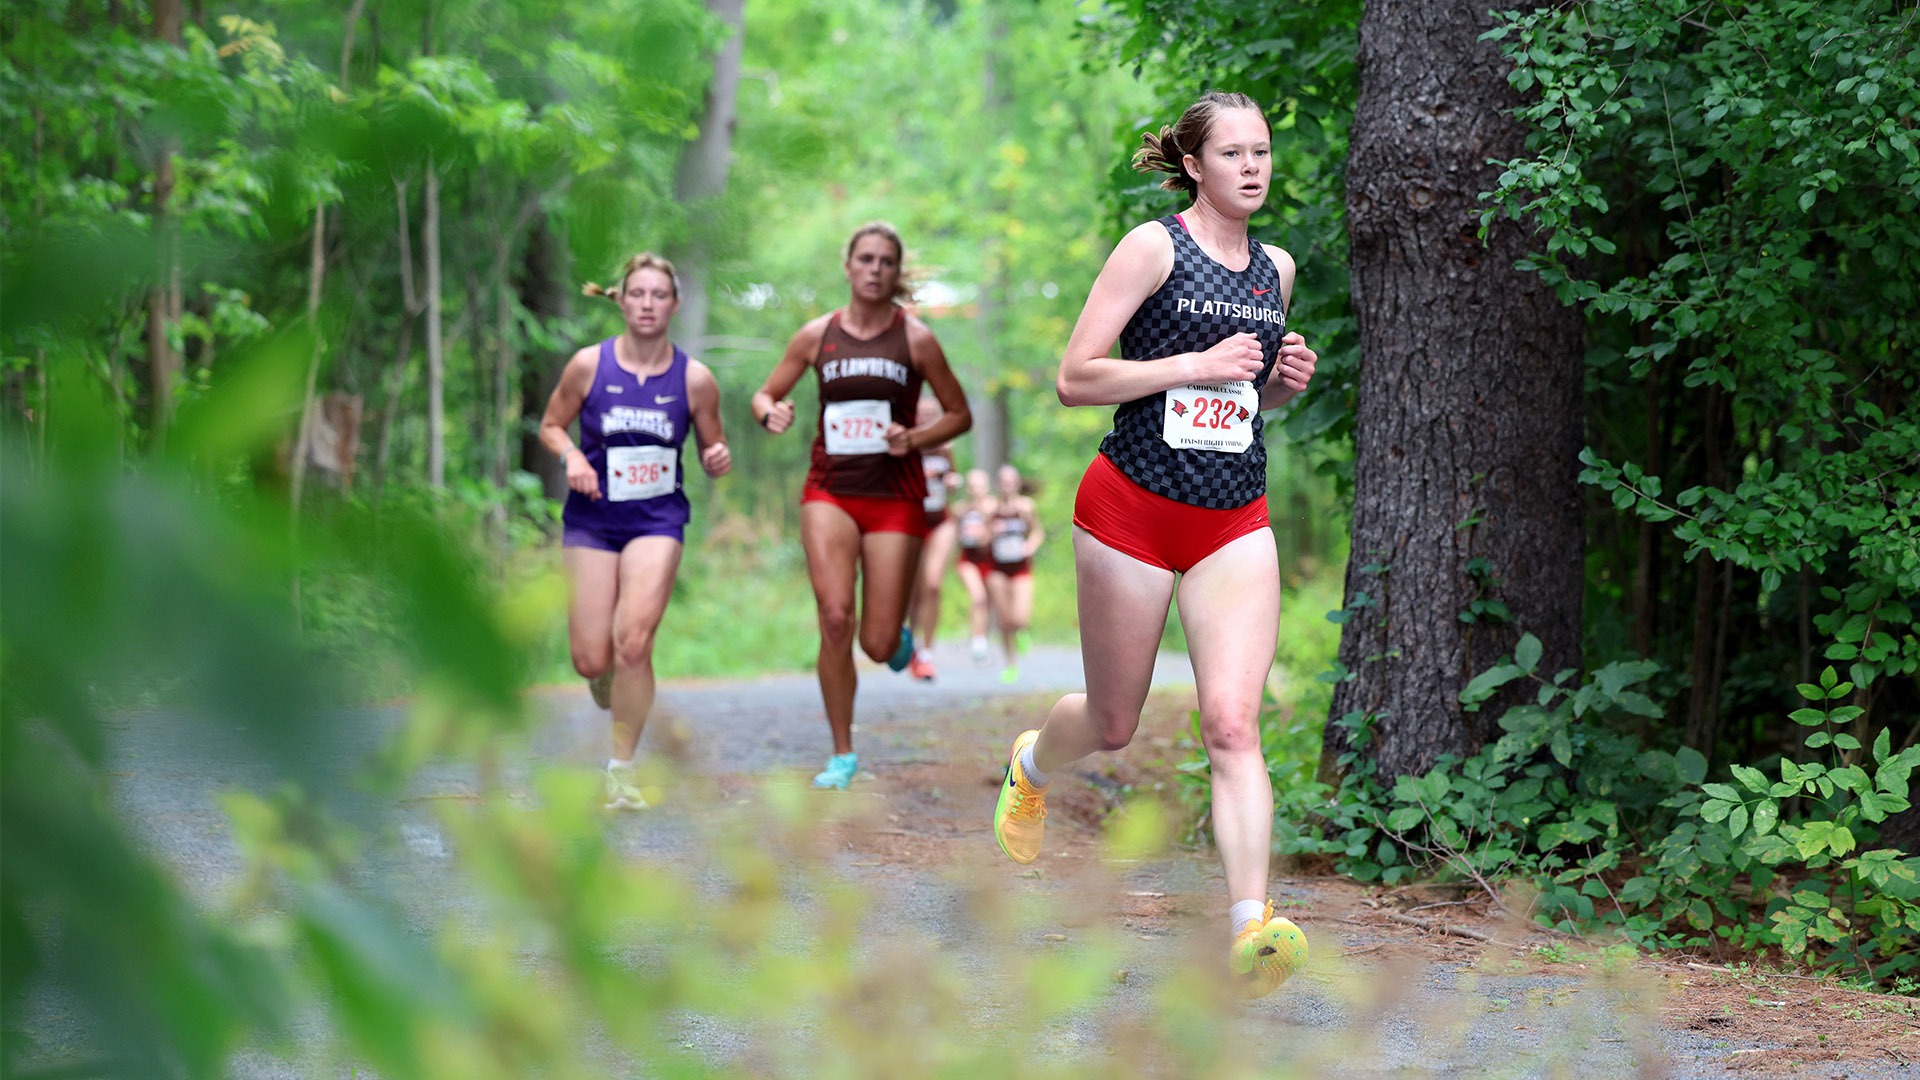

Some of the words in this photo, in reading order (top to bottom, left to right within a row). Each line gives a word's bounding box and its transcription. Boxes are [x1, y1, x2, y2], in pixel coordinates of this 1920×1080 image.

[1177, 298, 1285, 327] PLATTSBURGH
[840, 357, 908, 386] LAWRENCE
[1187, 384, 1220, 393] CARDINAL
[1220, 386, 1243, 395] CLASSIC
[1192, 397, 1237, 430] 232
[842, 417, 874, 439] 272
[1180, 438, 1203, 446] FINISH
[627, 463, 660, 485] 326
